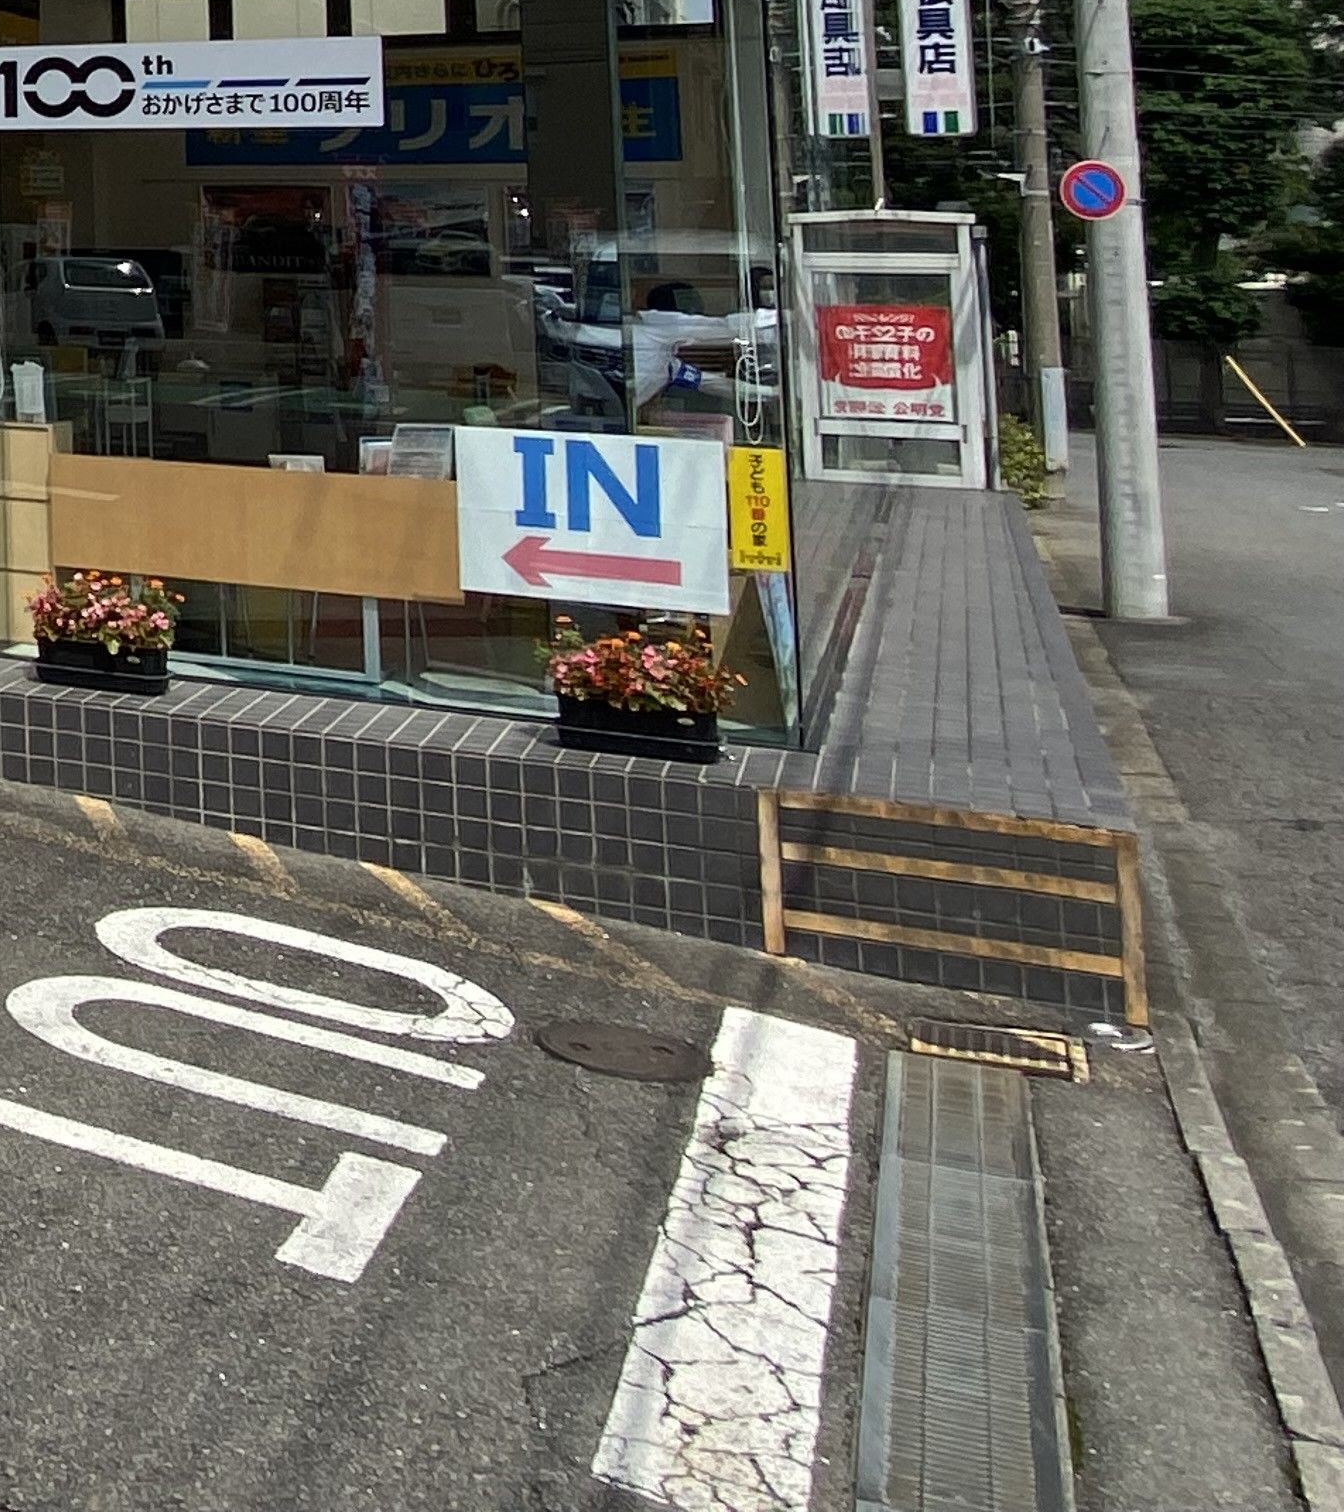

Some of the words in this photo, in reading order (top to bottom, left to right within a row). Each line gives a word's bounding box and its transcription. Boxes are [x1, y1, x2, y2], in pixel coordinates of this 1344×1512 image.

[141, 89, 372, 117] おかげさまで100周年
[512, 436, 662, 538] IN
